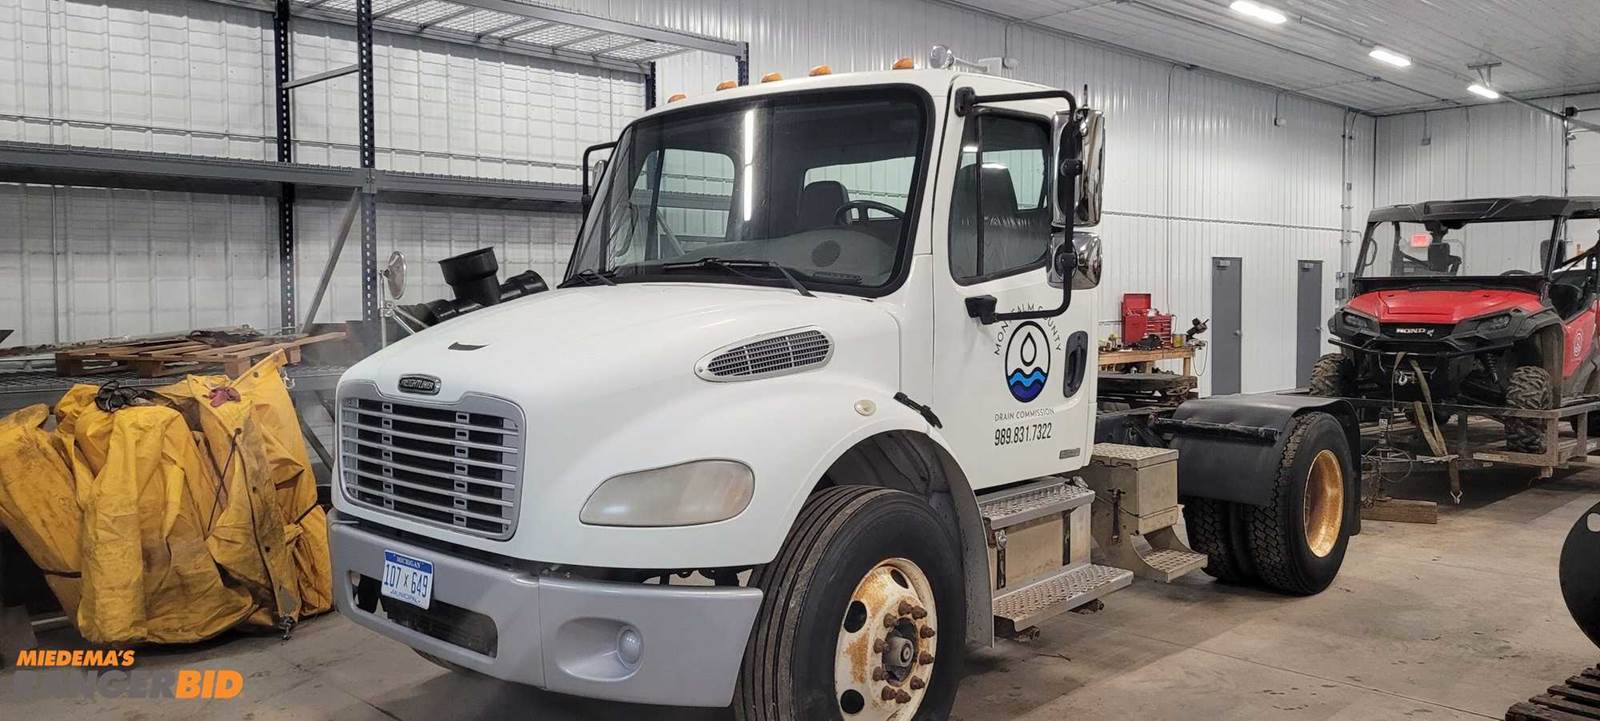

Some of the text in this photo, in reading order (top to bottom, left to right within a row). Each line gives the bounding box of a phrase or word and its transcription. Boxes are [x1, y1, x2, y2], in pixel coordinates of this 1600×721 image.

[994, 303, 1036, 356] MONCALM
[994, 408, 1055, 421] DRAIN COMMISSION
[994, 422, 1052, 446] 989.831.7322
